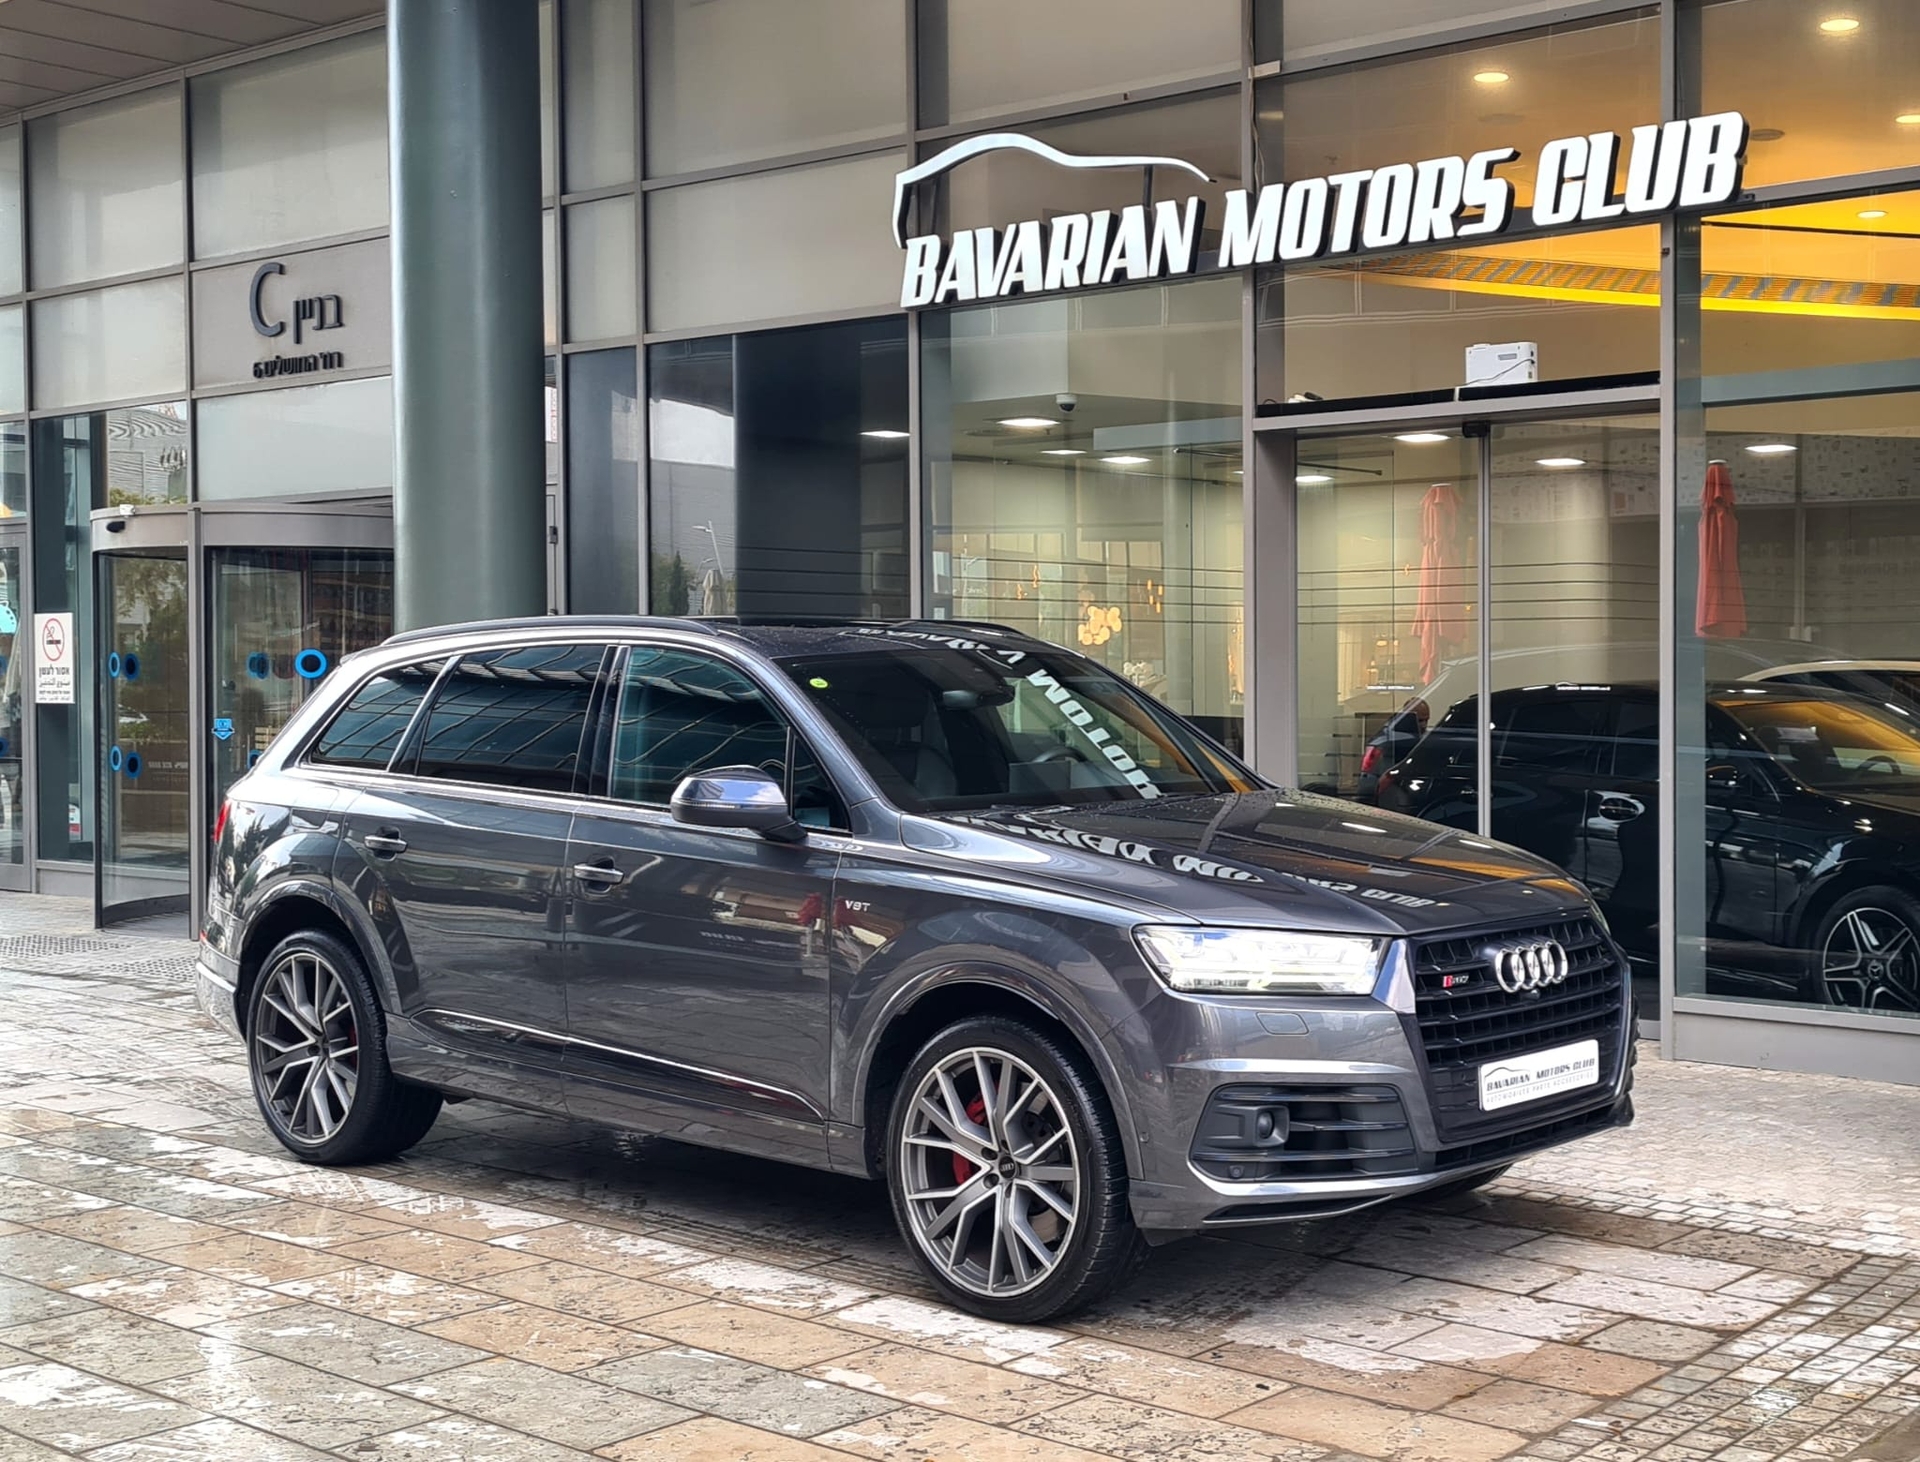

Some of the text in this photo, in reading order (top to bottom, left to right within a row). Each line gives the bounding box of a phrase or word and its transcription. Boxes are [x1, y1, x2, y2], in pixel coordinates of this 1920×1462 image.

[900, 110, 1747, 308] BAVARIAN MOTORS CLUB
[249, 261, 345, 345] בניין C
[253, 361, 264, 379] 6
[845, 899, 871, 912] V8T
[1486, 1058, 1595, 1092] BAVARIAN MOTORS CLUB
